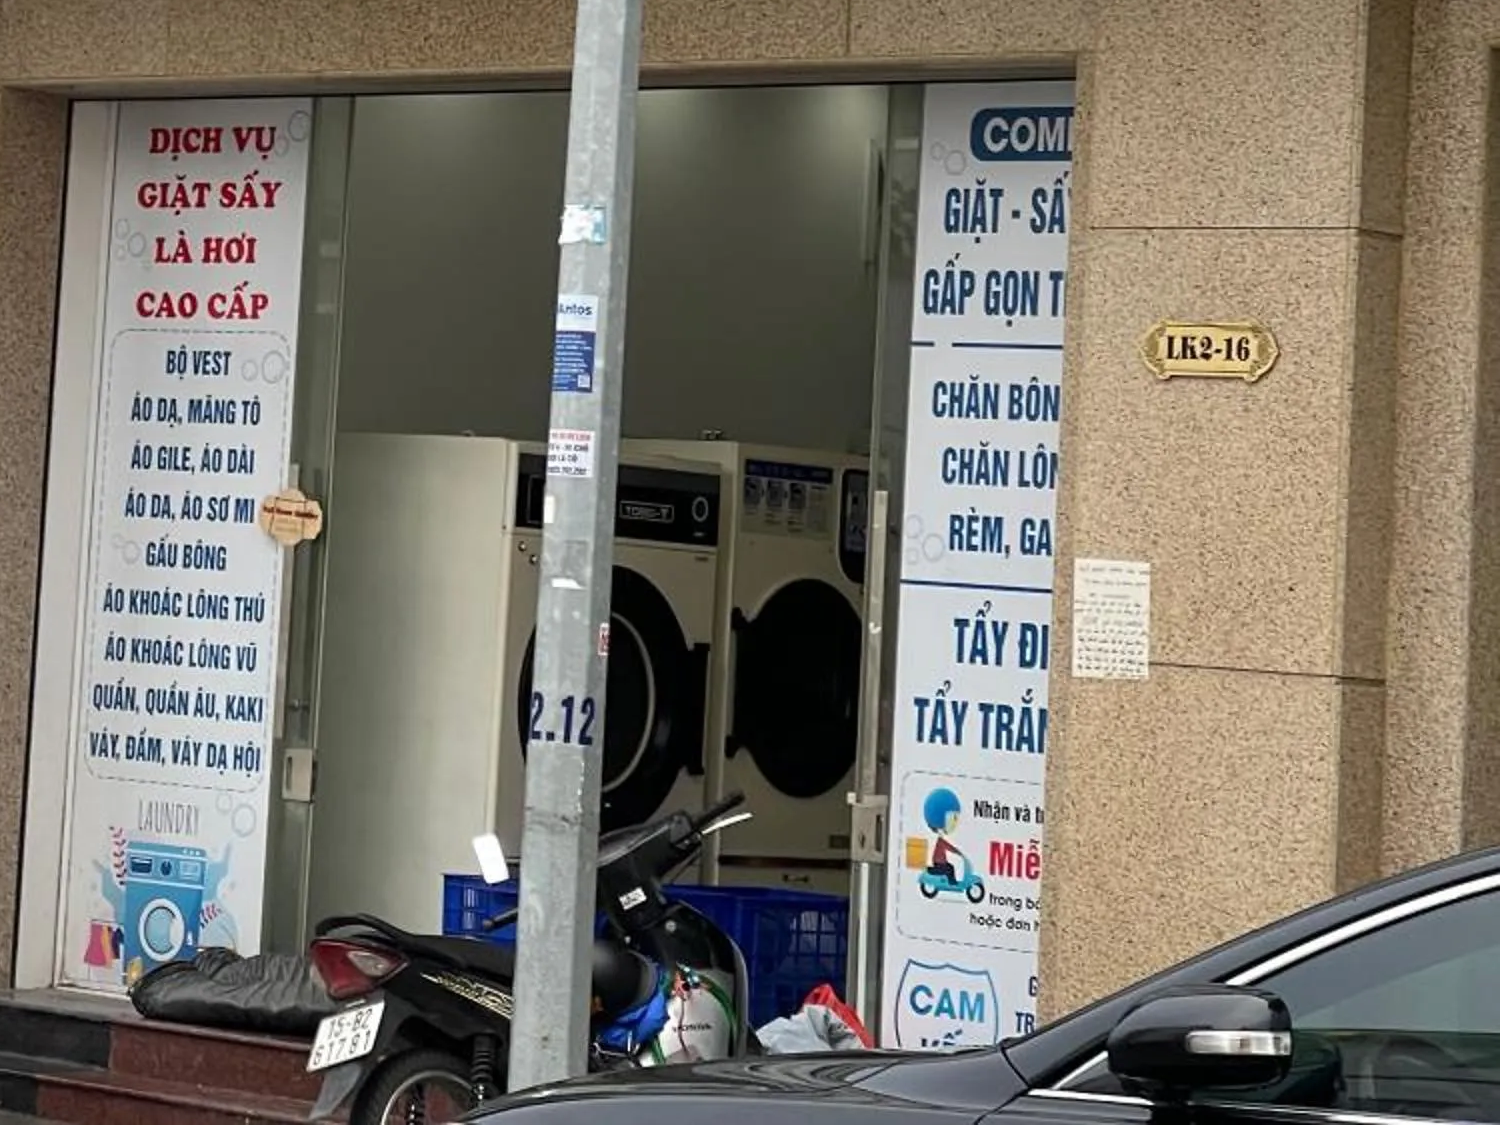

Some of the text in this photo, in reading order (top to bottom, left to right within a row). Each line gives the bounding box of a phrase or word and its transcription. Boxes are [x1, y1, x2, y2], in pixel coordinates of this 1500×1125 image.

[149, 126, 277, 161] DỊCH VỤ
[983, 116, 1072, 153] COM
[137, 170, 282, 216] GIẶT SẤY
[944, 178, 1004, 244] GIẶT
[1029, 170, 1072, 234] SẤ
[154, 230, 257, 264] LÀ HƠI
[136, 280, 269, 319] CAO CẤP
[923, 252, 1067, 327] GẤP GỌN T
[166, 344, 233, 380] BỘ VEST
[1165, 335, 1250, 362] LK2-16
[131, 391, 153, 422] ÁO
[157, 397, 183, 428] DẠ,
[932, 374, 1001, 420] CHĂN
[131, 439, 153, 470] ÁO
[157, 446, 195, 475] GILE,
[200, 442, 223, 473] ÁO
[941, 440, 1011, 487] CHĂN
[124, 486, 146, 518] ÁO
[150, 494, 176, 521] DA,
[181, 490, 203, 520] ÁO
[207, 494, 231, 521] SƠ
[233, 498, 255, 523] MI
[146, 533, 228, 571] GẤU BÔNG
[949, 506, 1011, 559] RÈM,
[103, 582, 265, 623] ÁO KHOÁC LÔNG THÚ
[104, 630, 126, 661] ÁO
[130, 635, 184, 666] KHOÁC
[188, 638, 231, 670] LÔNG
[953, 600, 1009, 667] TẨY
[225, 694, 264, 723] KAKI
[913, 680, 969, 746] TẨY
[171, 735, 202, 766] VÁY
[206, 742, 227, 775] DẠ
[233, 740, 261, 777] HỘI
[138, 798, 199, 837] LAUNDRY
[973, 799, 1010, 824] Nhận
[1014, 804, 1031, 823] và
[989, 893, 1023, 912] trong
[908, 984, 985, 1024] CAM
